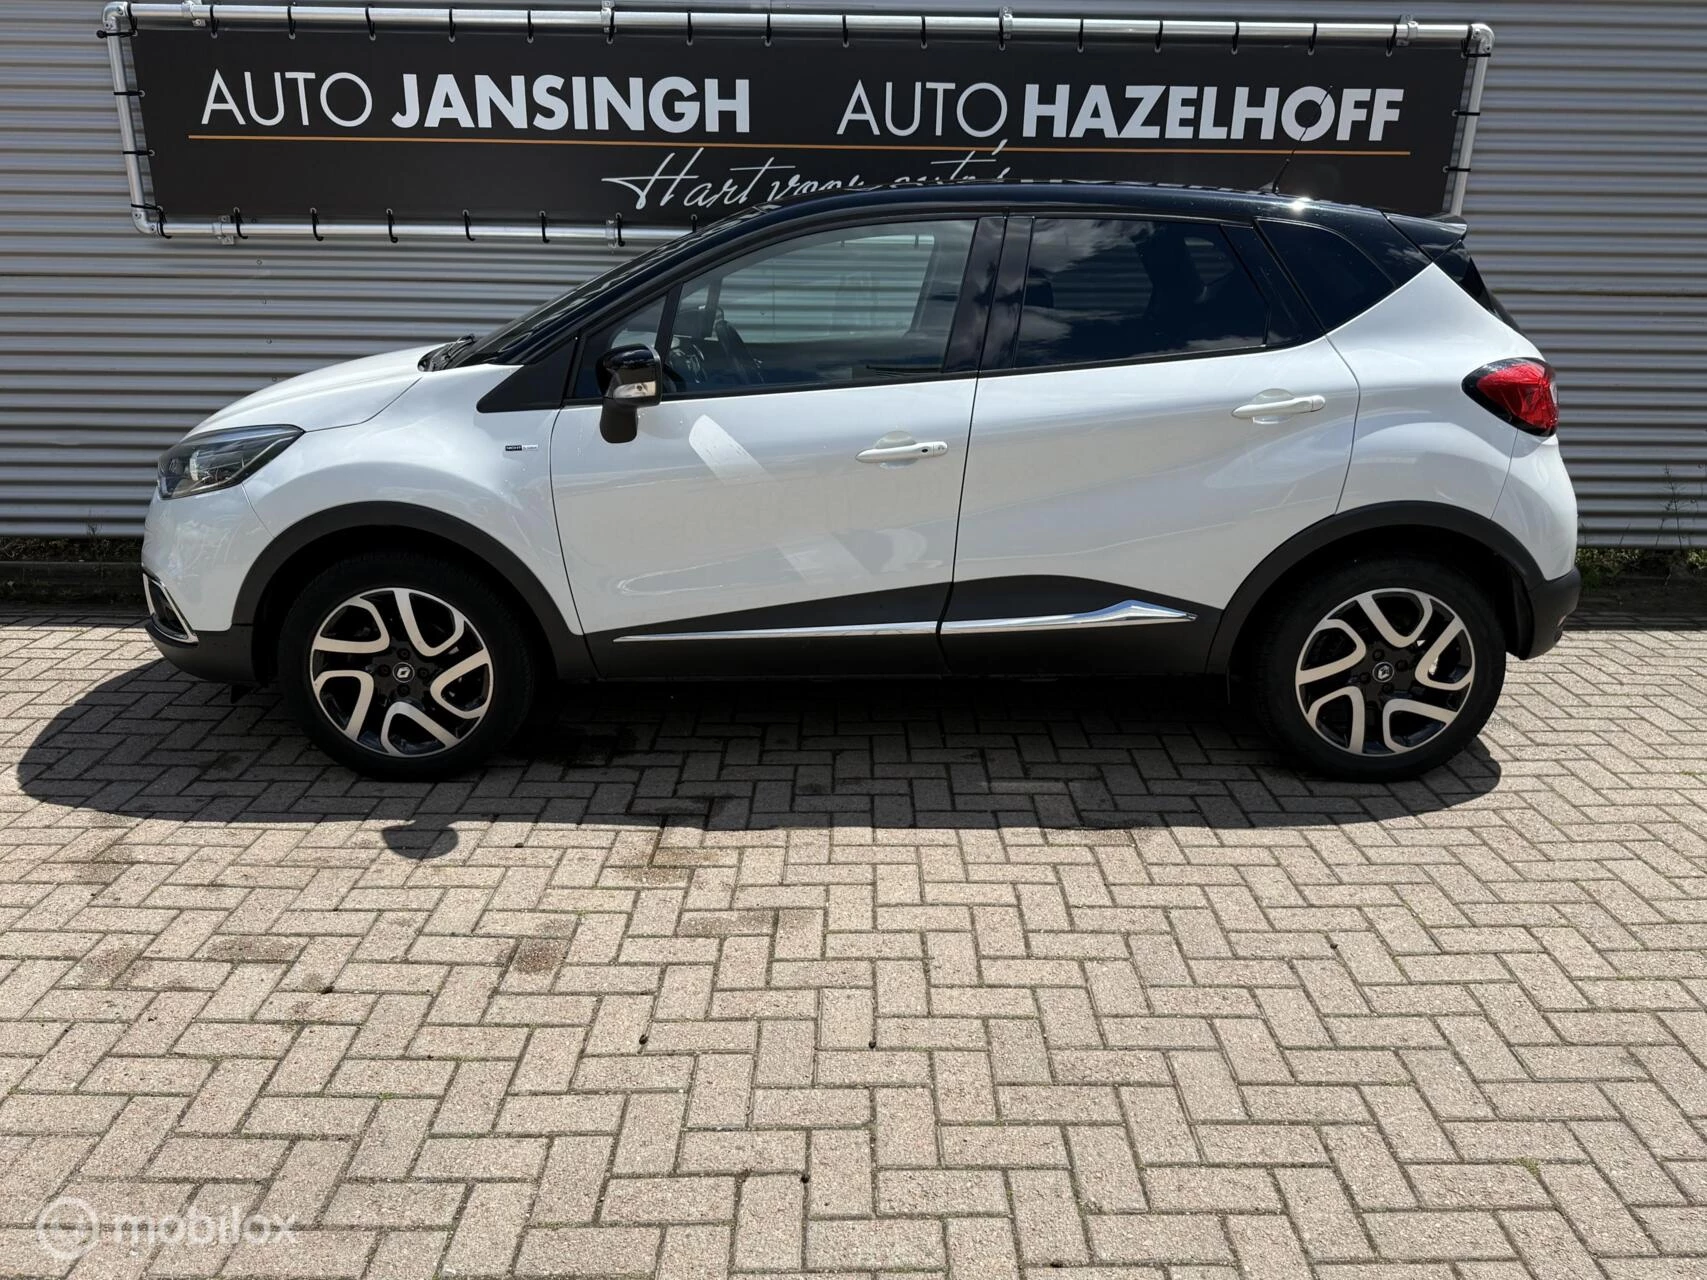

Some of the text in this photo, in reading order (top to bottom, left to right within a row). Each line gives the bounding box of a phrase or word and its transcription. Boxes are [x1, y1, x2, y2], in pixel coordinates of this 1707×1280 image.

[201, 69, 750, 133] AUTO JANSINGH
[836, 79, 1404, 142] AUTO HAZELHOFF
[601, 146, 797, 211] Hart
